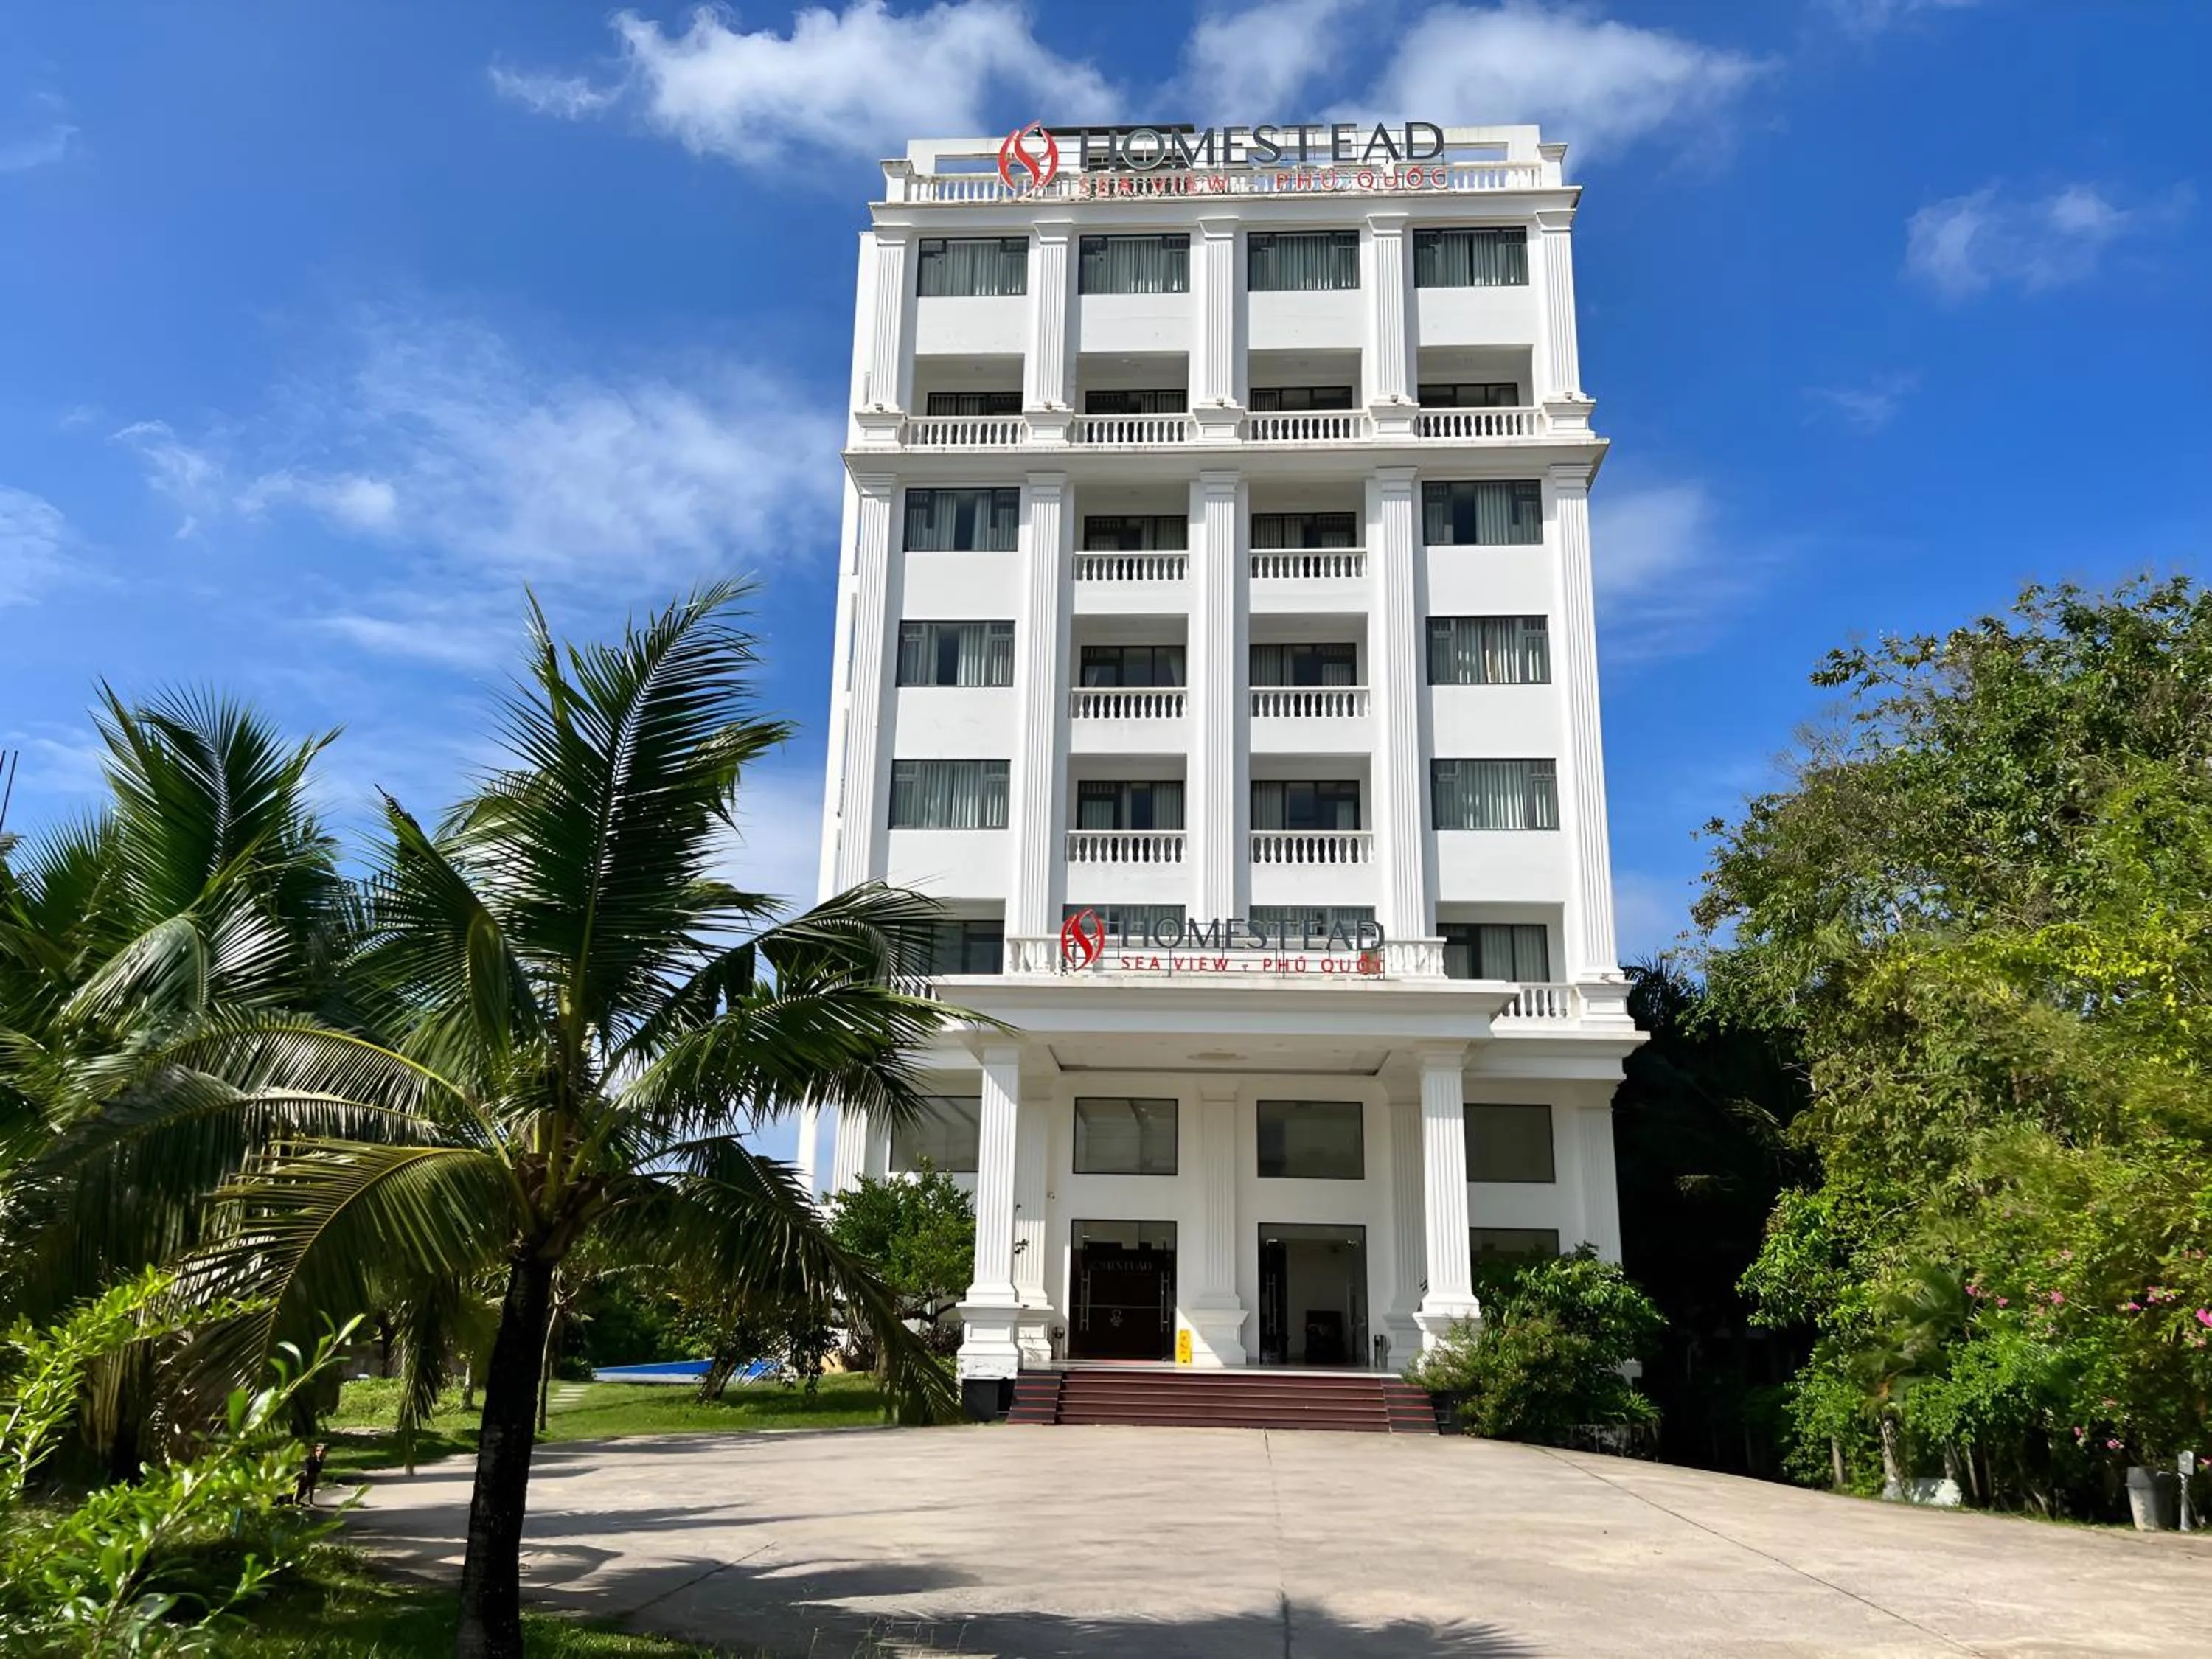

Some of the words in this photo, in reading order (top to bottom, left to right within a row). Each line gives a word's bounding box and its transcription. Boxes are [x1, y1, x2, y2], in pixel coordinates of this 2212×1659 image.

[1080, 122, 1444, 170] HOMESTEAD
[1121, 917, 1385, 951] HOMESTEAD
[1121, 956, 1161, 971] SEA
[1174, 956, 1230, 972] VIEW
